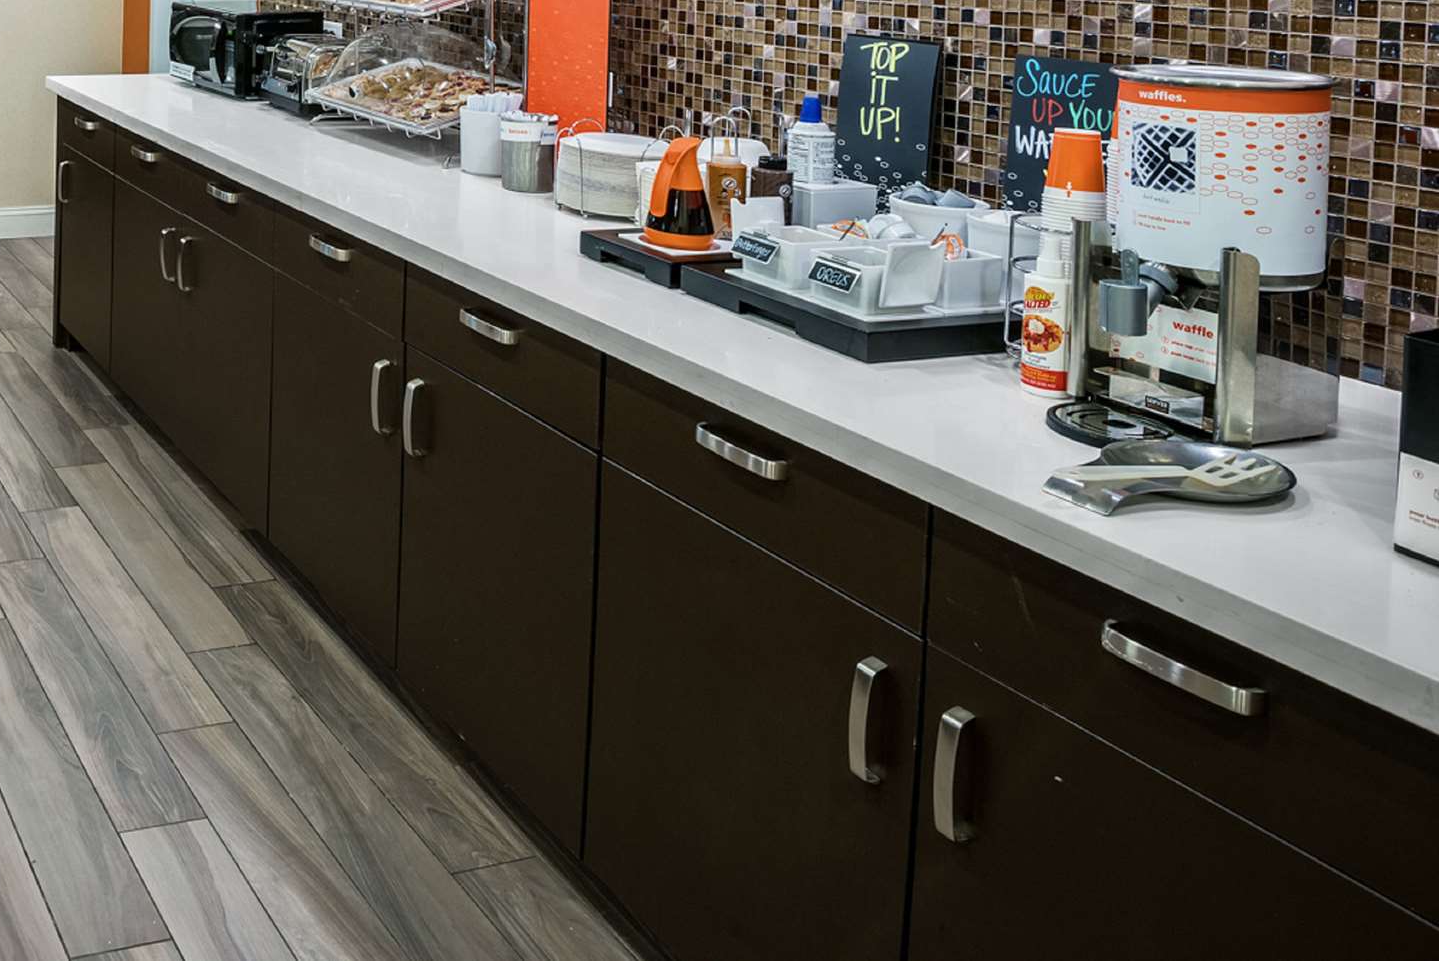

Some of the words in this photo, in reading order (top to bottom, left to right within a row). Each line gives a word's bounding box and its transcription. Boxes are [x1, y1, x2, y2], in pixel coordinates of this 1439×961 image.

[860, 42, 910, 73] TOP
[1138, 89, 1187, 103] waffles.
[860, 106, 901, 143] UP!
[1032, 97, 1064, 126] UP
[1173, 321, 1215, 340] waffle
